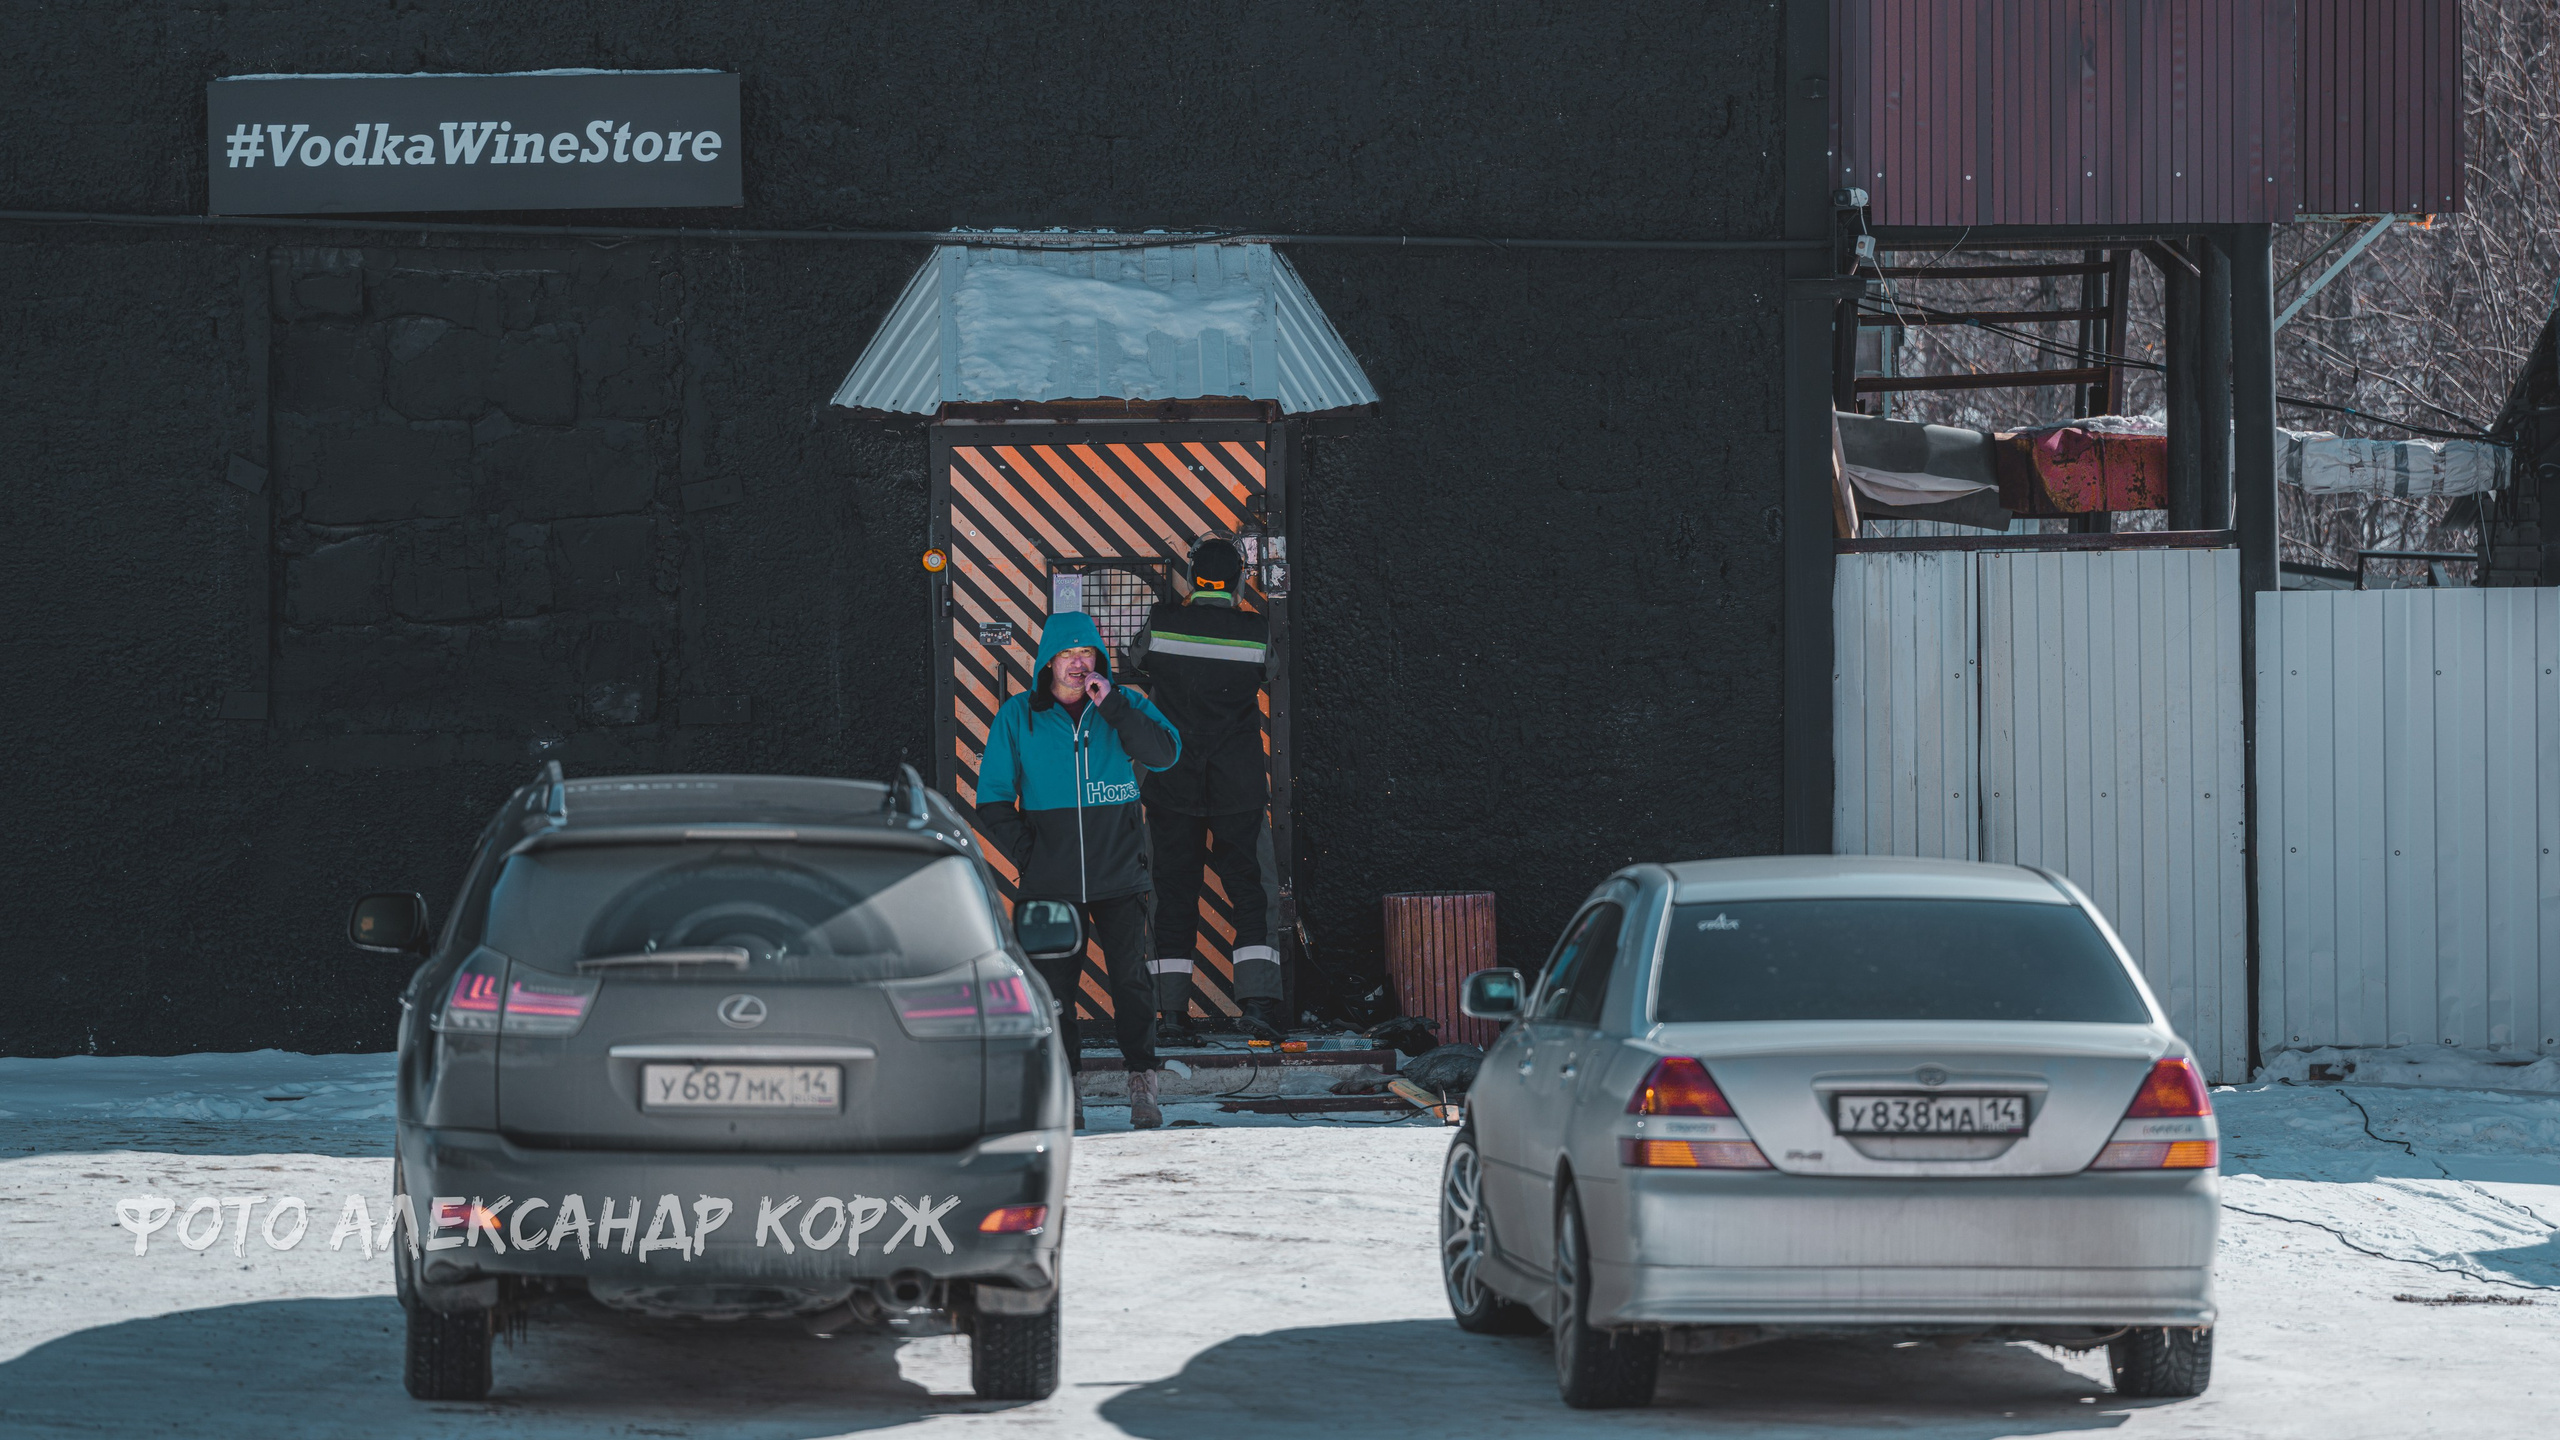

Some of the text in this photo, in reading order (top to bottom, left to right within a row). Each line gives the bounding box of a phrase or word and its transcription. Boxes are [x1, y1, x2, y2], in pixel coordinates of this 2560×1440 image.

[226, 120, 722, 168] #VodkaWineStore
[799, 1070, 828, 1094] 14
[1986, 1098, 2016, 1122] 14
